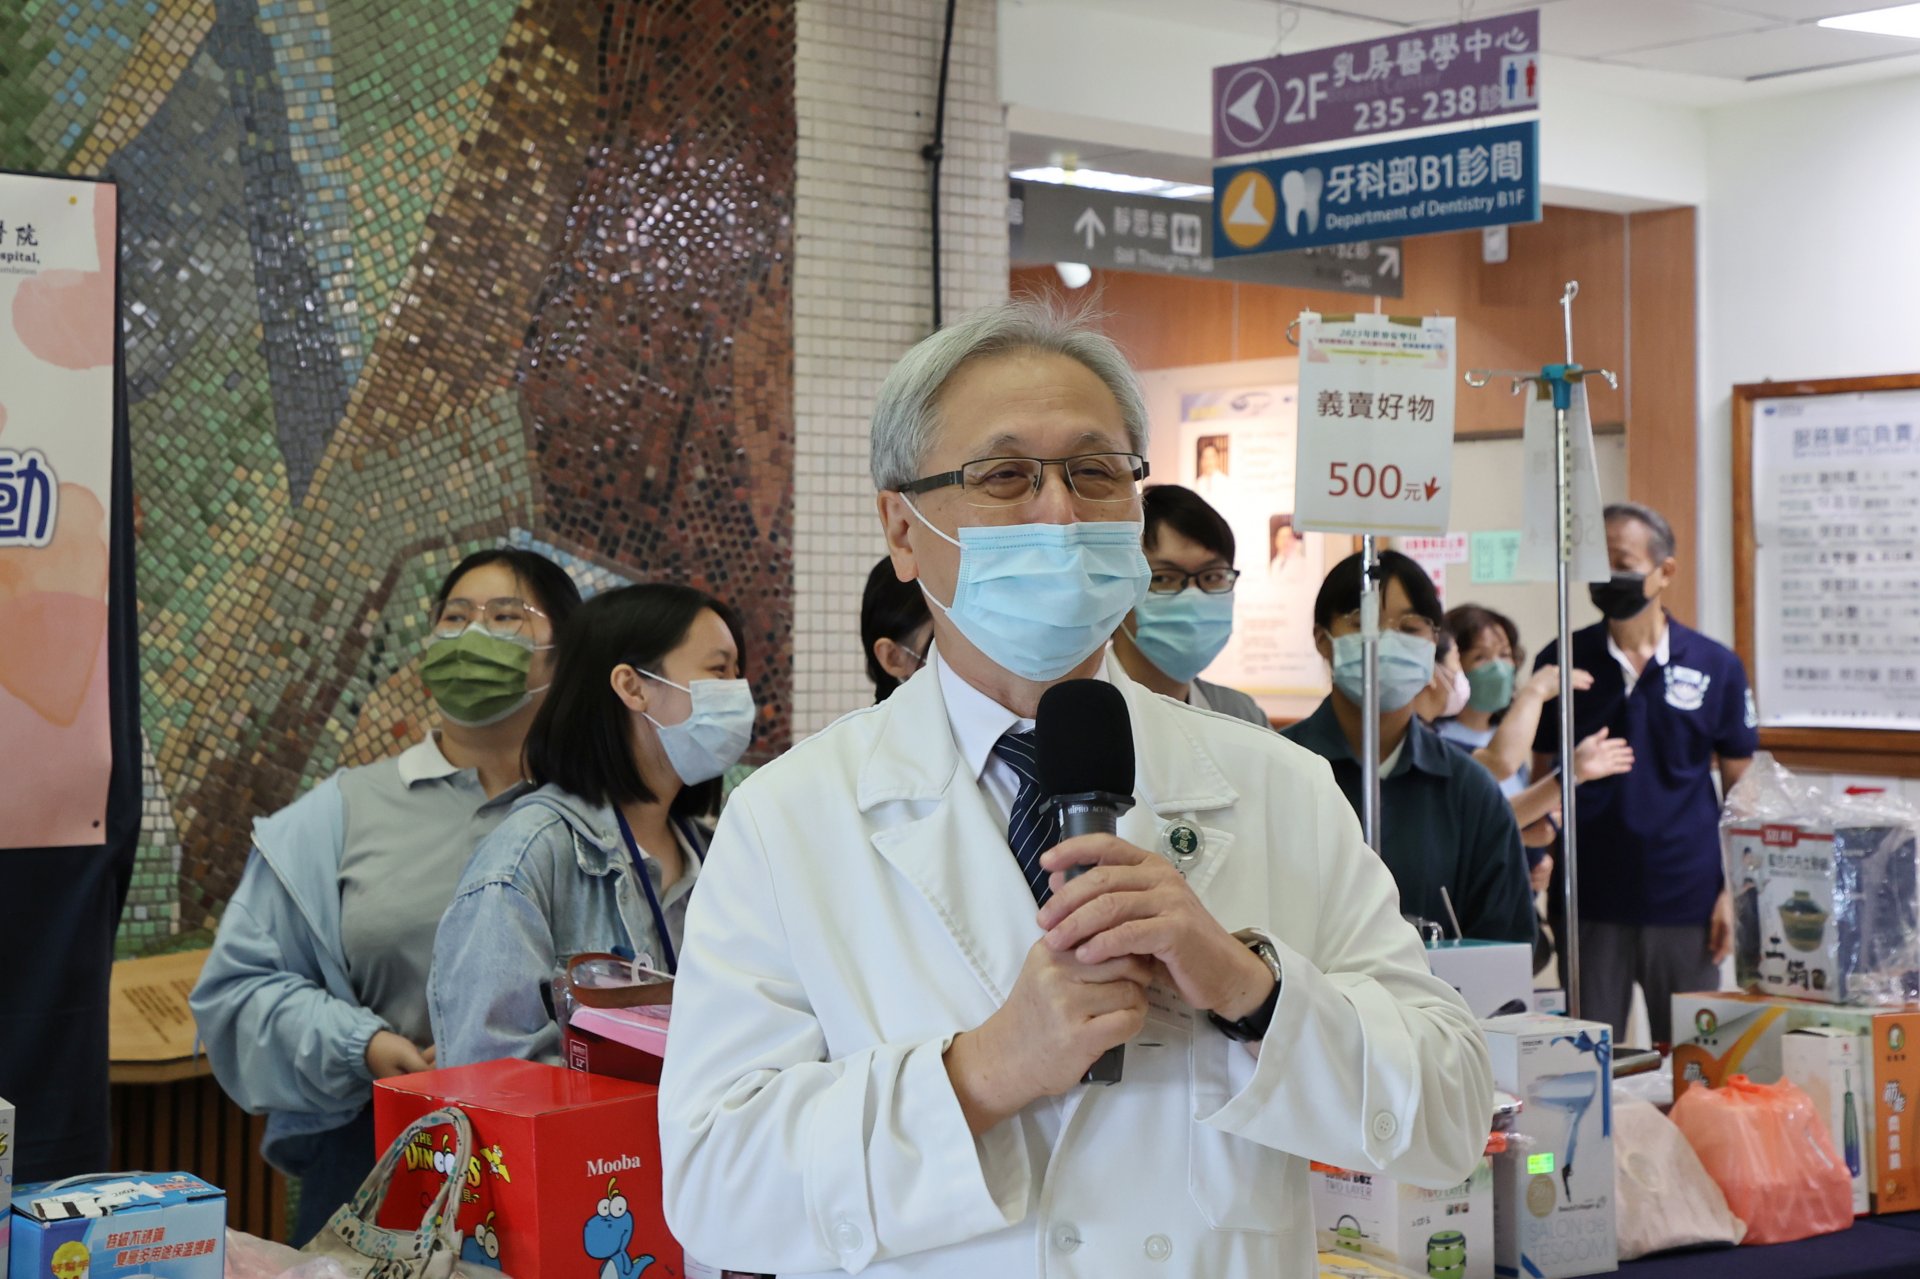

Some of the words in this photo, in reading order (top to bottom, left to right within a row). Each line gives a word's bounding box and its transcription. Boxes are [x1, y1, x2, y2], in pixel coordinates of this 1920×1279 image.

[1284, 72, 1328, 124] 2F
[1332, 26, 1530, 87] 乳房醫學中心
[1326, 140, 1523, 204] 牙科部B1診間
[1325, 207, 1408, 230] Department
[1409, 203, 1426, 220] of
[1427, 193, 1495, 217] Dentistry
[1496, 189, 1526, 207] B1F
[1317, 390, 1435, 422] 義賣好物
[1328, 461, 1421, 501] 500元
[586, 1154, 641, 1177] Mooba
